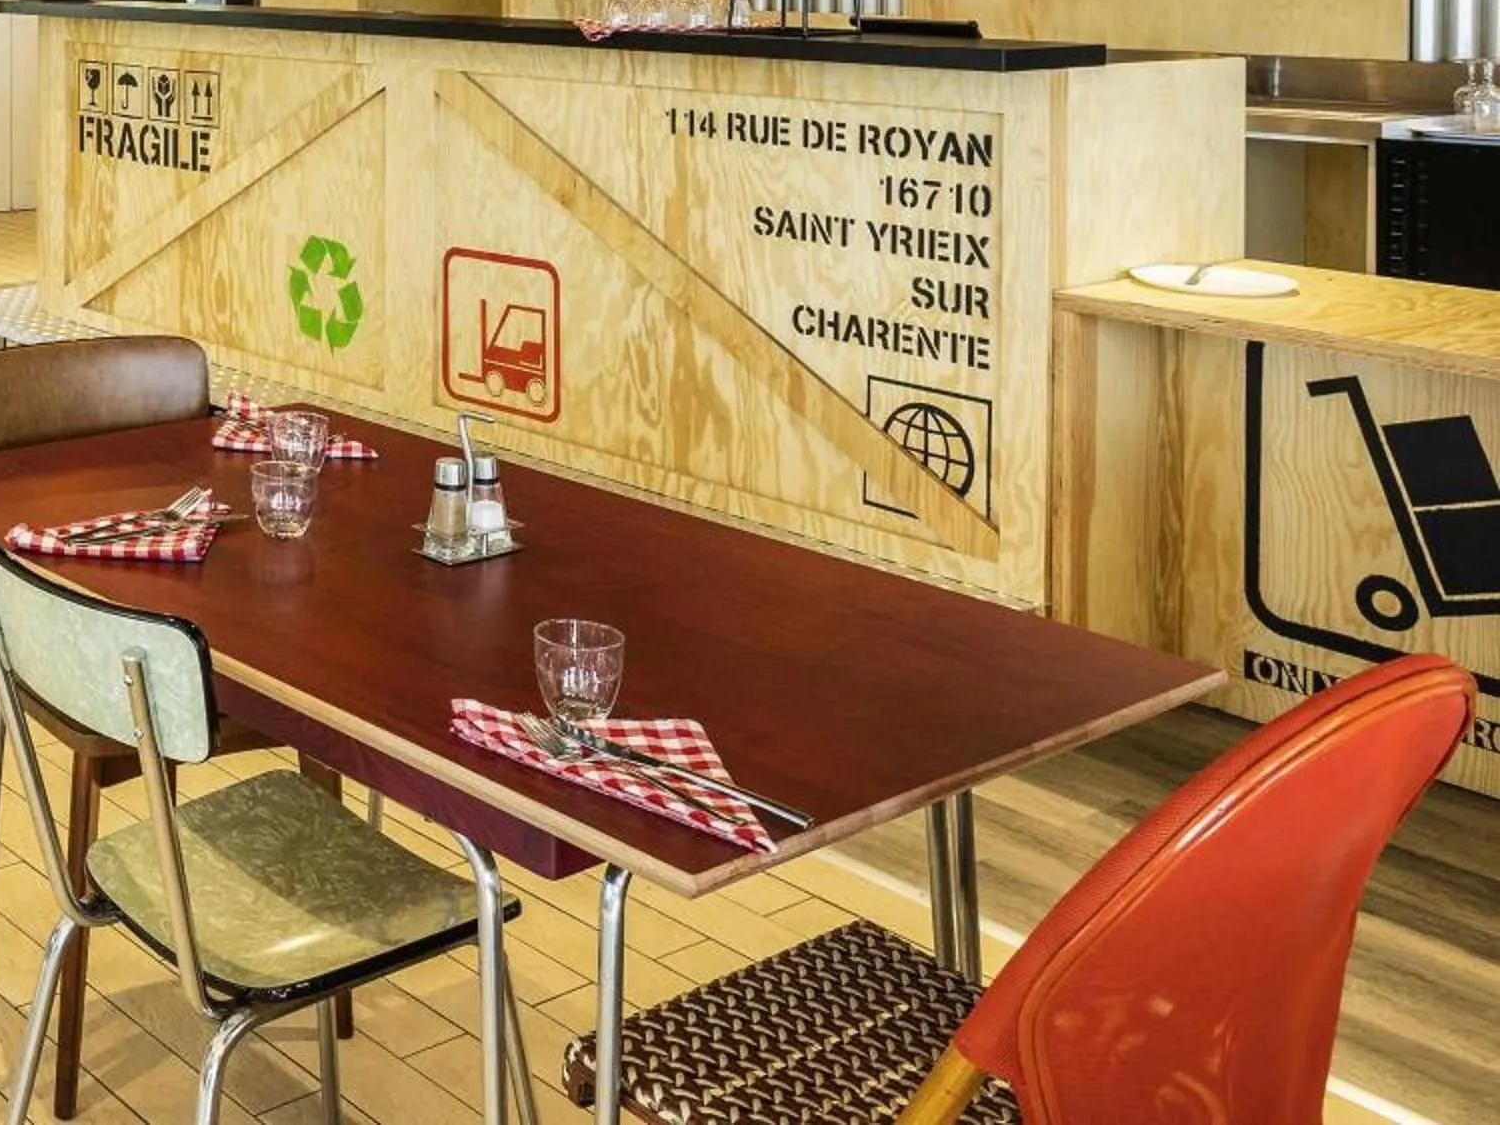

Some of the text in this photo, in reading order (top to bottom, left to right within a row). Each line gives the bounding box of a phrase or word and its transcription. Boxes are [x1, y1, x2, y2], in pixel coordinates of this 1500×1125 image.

[79, 116, 211, 172] FRAGILE
[665, 108, 993, 167] 114 RUE DE ROYAN
[880, 176, 991, 217] 16710
[753, 206, 990, 268] SAINT YRIEIX
[911, 277, 989, 318] SUR
[792, 304, 990, 369] CHARENTE
